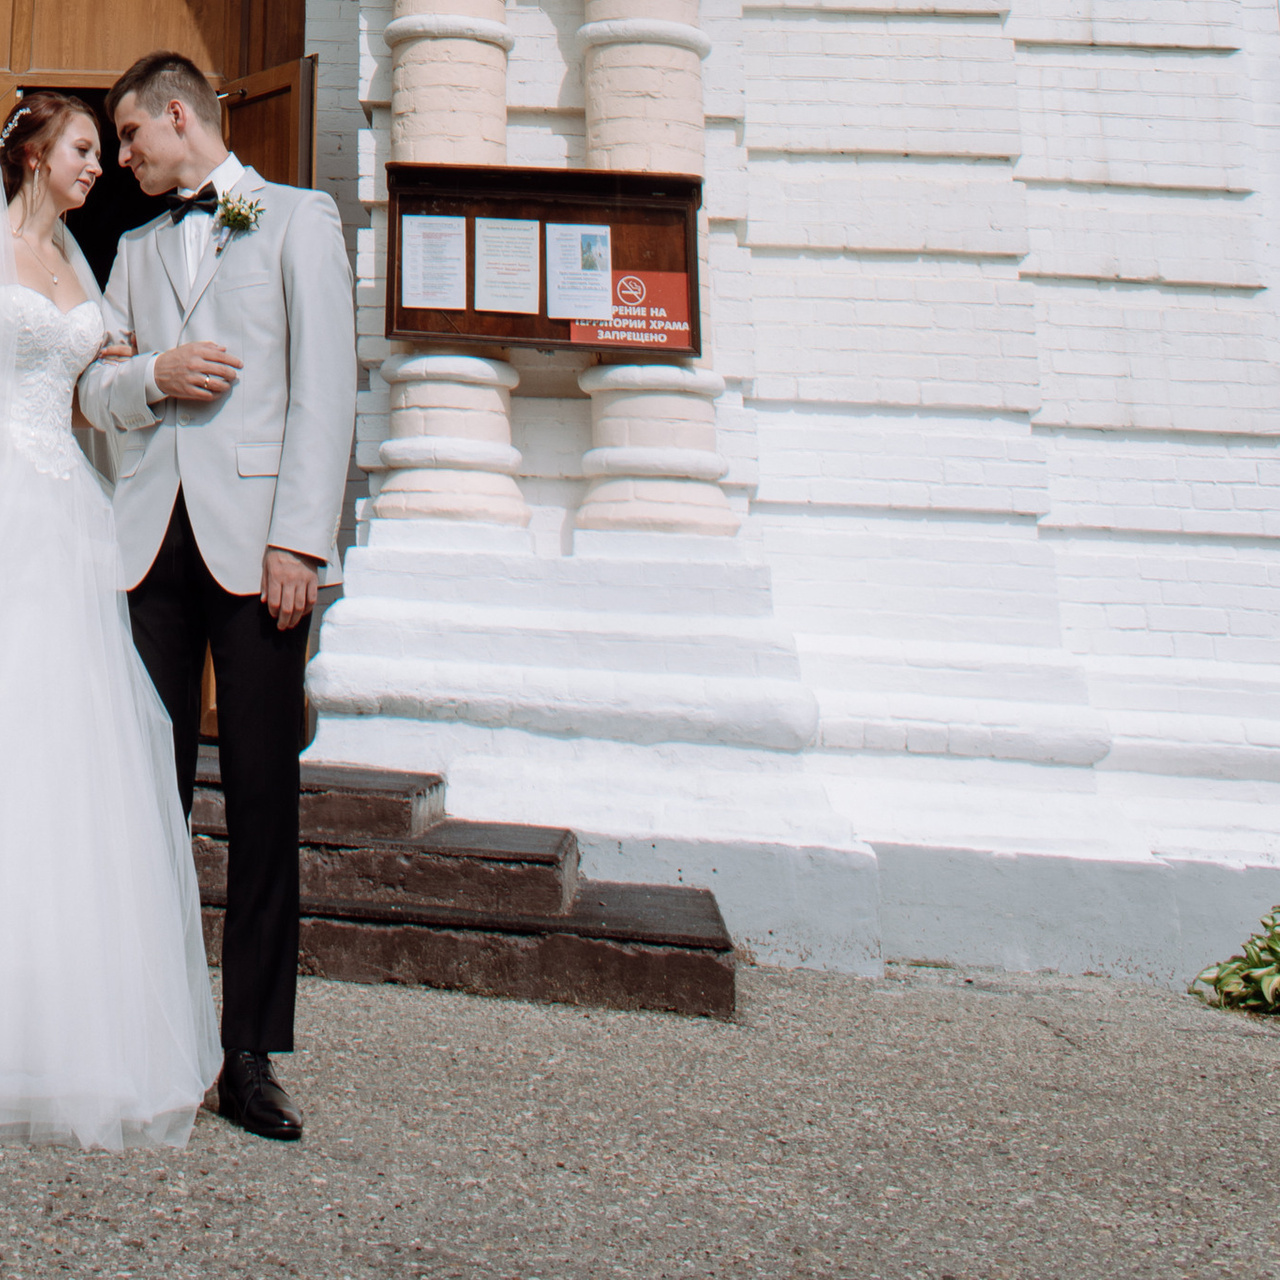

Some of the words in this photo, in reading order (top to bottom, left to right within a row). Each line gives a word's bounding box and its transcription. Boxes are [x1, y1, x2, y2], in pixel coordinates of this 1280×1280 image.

[612, 305, 647, 316] РЕНИЕ
[650, 307, 667, 317] НА
[649, 320, 690, 331] ХРАМА
[597, 329, 668, 343] ЗАПРЕЩЕНО
